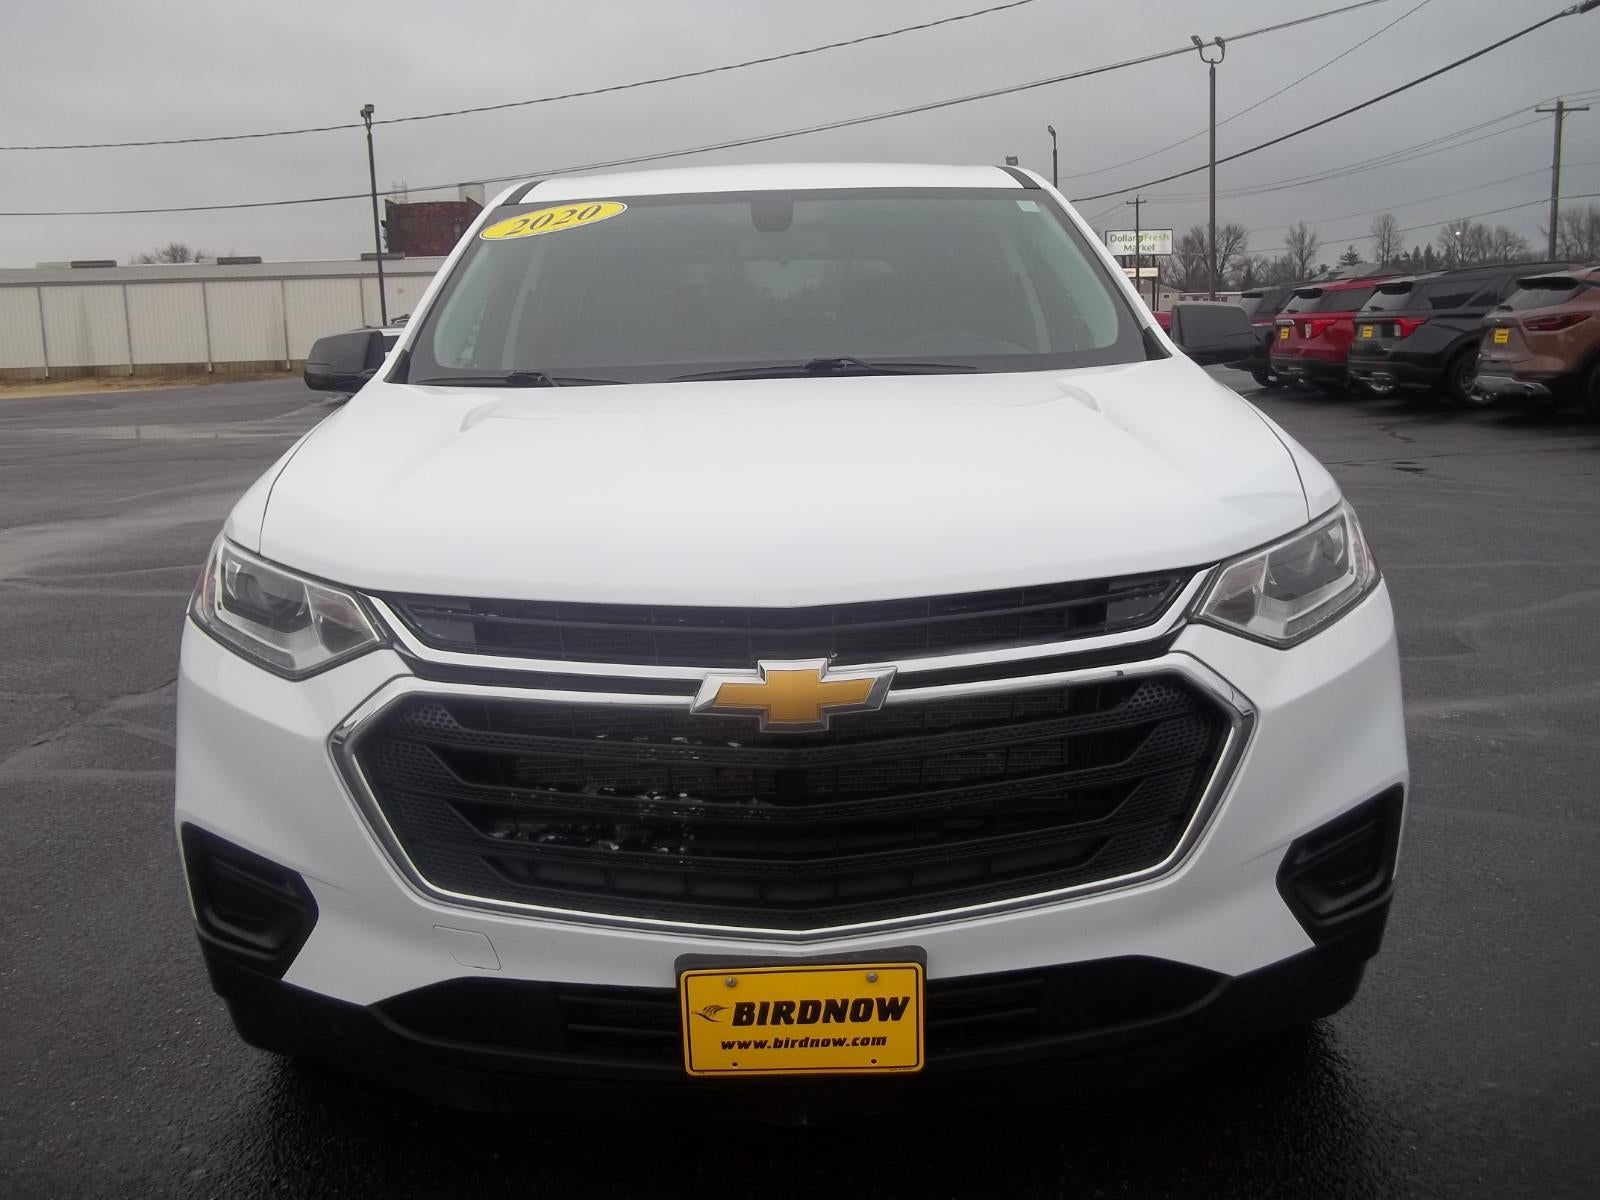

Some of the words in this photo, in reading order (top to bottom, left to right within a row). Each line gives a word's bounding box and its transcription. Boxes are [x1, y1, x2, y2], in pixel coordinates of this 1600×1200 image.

[503, 204, 602, 236] 2020
[1110, 234, 1137, 243] Dollar
[1144, 232, 1169, 241] Fresh
[732, 996, 910, 1026] BIRDNOW
[720, 1036, 887, 1050] www.birdnow.com
